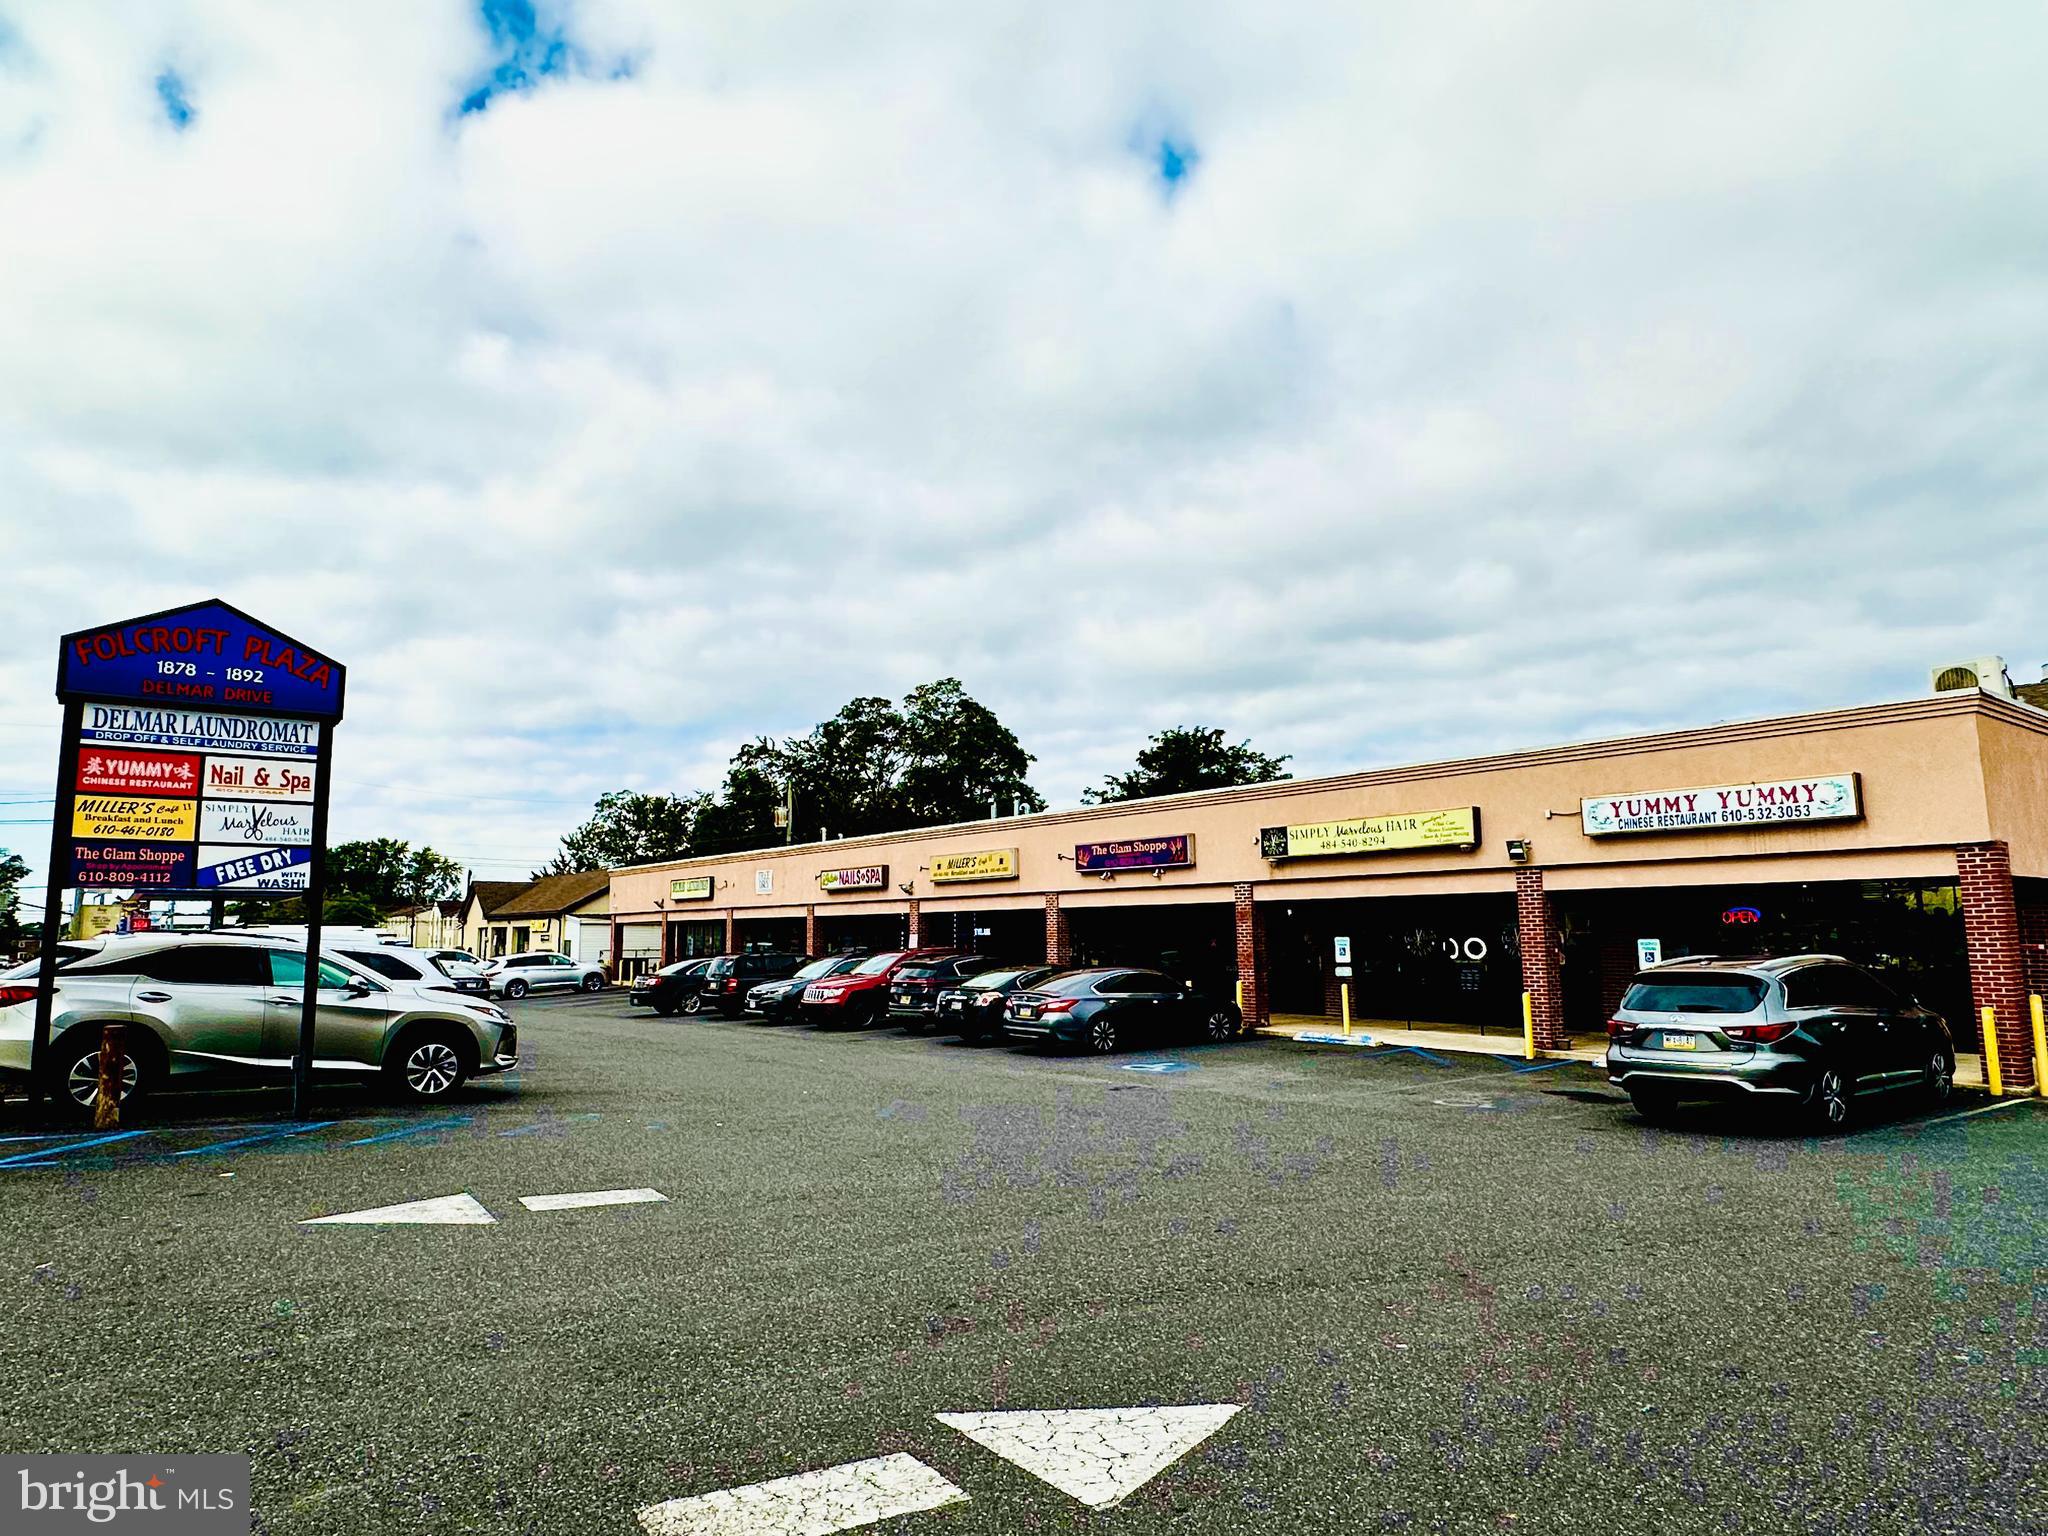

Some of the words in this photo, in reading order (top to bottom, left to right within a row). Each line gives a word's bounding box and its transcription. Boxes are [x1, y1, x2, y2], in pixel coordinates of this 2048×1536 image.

[74, 626, 231, 665] FOLCROFT
[243, 636, 331, 689] PLAZA
[157, 660, 197, 677] 1878
[225, 667, 264, 683] 1892
[143, 680, 214, 699] DELMAR
[224, 688, 273, 704] DRIVE
[92, 707, 177, 734] DELMAR
[182, 714, 313, 743] LAUNDROMAT
[95, 731, 131, 741] DROP
[135, 733, 157, 743] OFF
[160, 735, 169, 744] &
[172, 736, 201, 746] SELF
[204, 739, 258, 750] LAUNDRY
[261, 743, 307, 754] SERVICE
[105, 758, 174, 778] YUMMY
[82, 776, 126, 786] CHINESE
[128, 779, 193, 789] RESTAURANT
[211, 764, 243, 786] Nail
[254, 767, 270, 787] &
[280, 769, 311, 795] Spa
[77, 800, 156, 814] MILLER'S
[205, 804, 250, 813] SIMPLY
[1610, 794, 1698, 818] YUMMY
[1717, 783, 1818, 809] YUMMY
[84, 813, 131, 823] Breakfast
[133, 816, 151, 824] and
[154, 816, 184, 825] Lunch
[1618, 816, 1654, 830] CHINESE
[1657, 811, 1718, 827] RESTAURANT
[1721, 804, 1811, 823] 610-532-3053
[93, 824, 175, 837] 610-461-0180
[282, 828, 310, 836] HAIR
[1289, 827, 1330, 840] SIMPLY
[1386, 818, 1417, 832] HAIR
[75, 847, 100, 860] The
[103, 848, 136, 860] Glam
[139, 848, 185, 864] Shoppe
[1091, 845, 1107, 856] The
[1109, 843, 1132, 855] Glam
[1133, 841, 1167, 854] Shoppe
[215, 858, 257, 882] FREE
[260, 849, 292, 871] DRY
[947, 856, 977, 869] MILLER'S
[78, 871, 171, 883] 610-809-4112
[257, 878, 305, 888] WASH!
[839, 869, 860, 885] NAILS
[865, 868, 881, 884] SPA
[1722, 910, 1760, 924] OPEN
